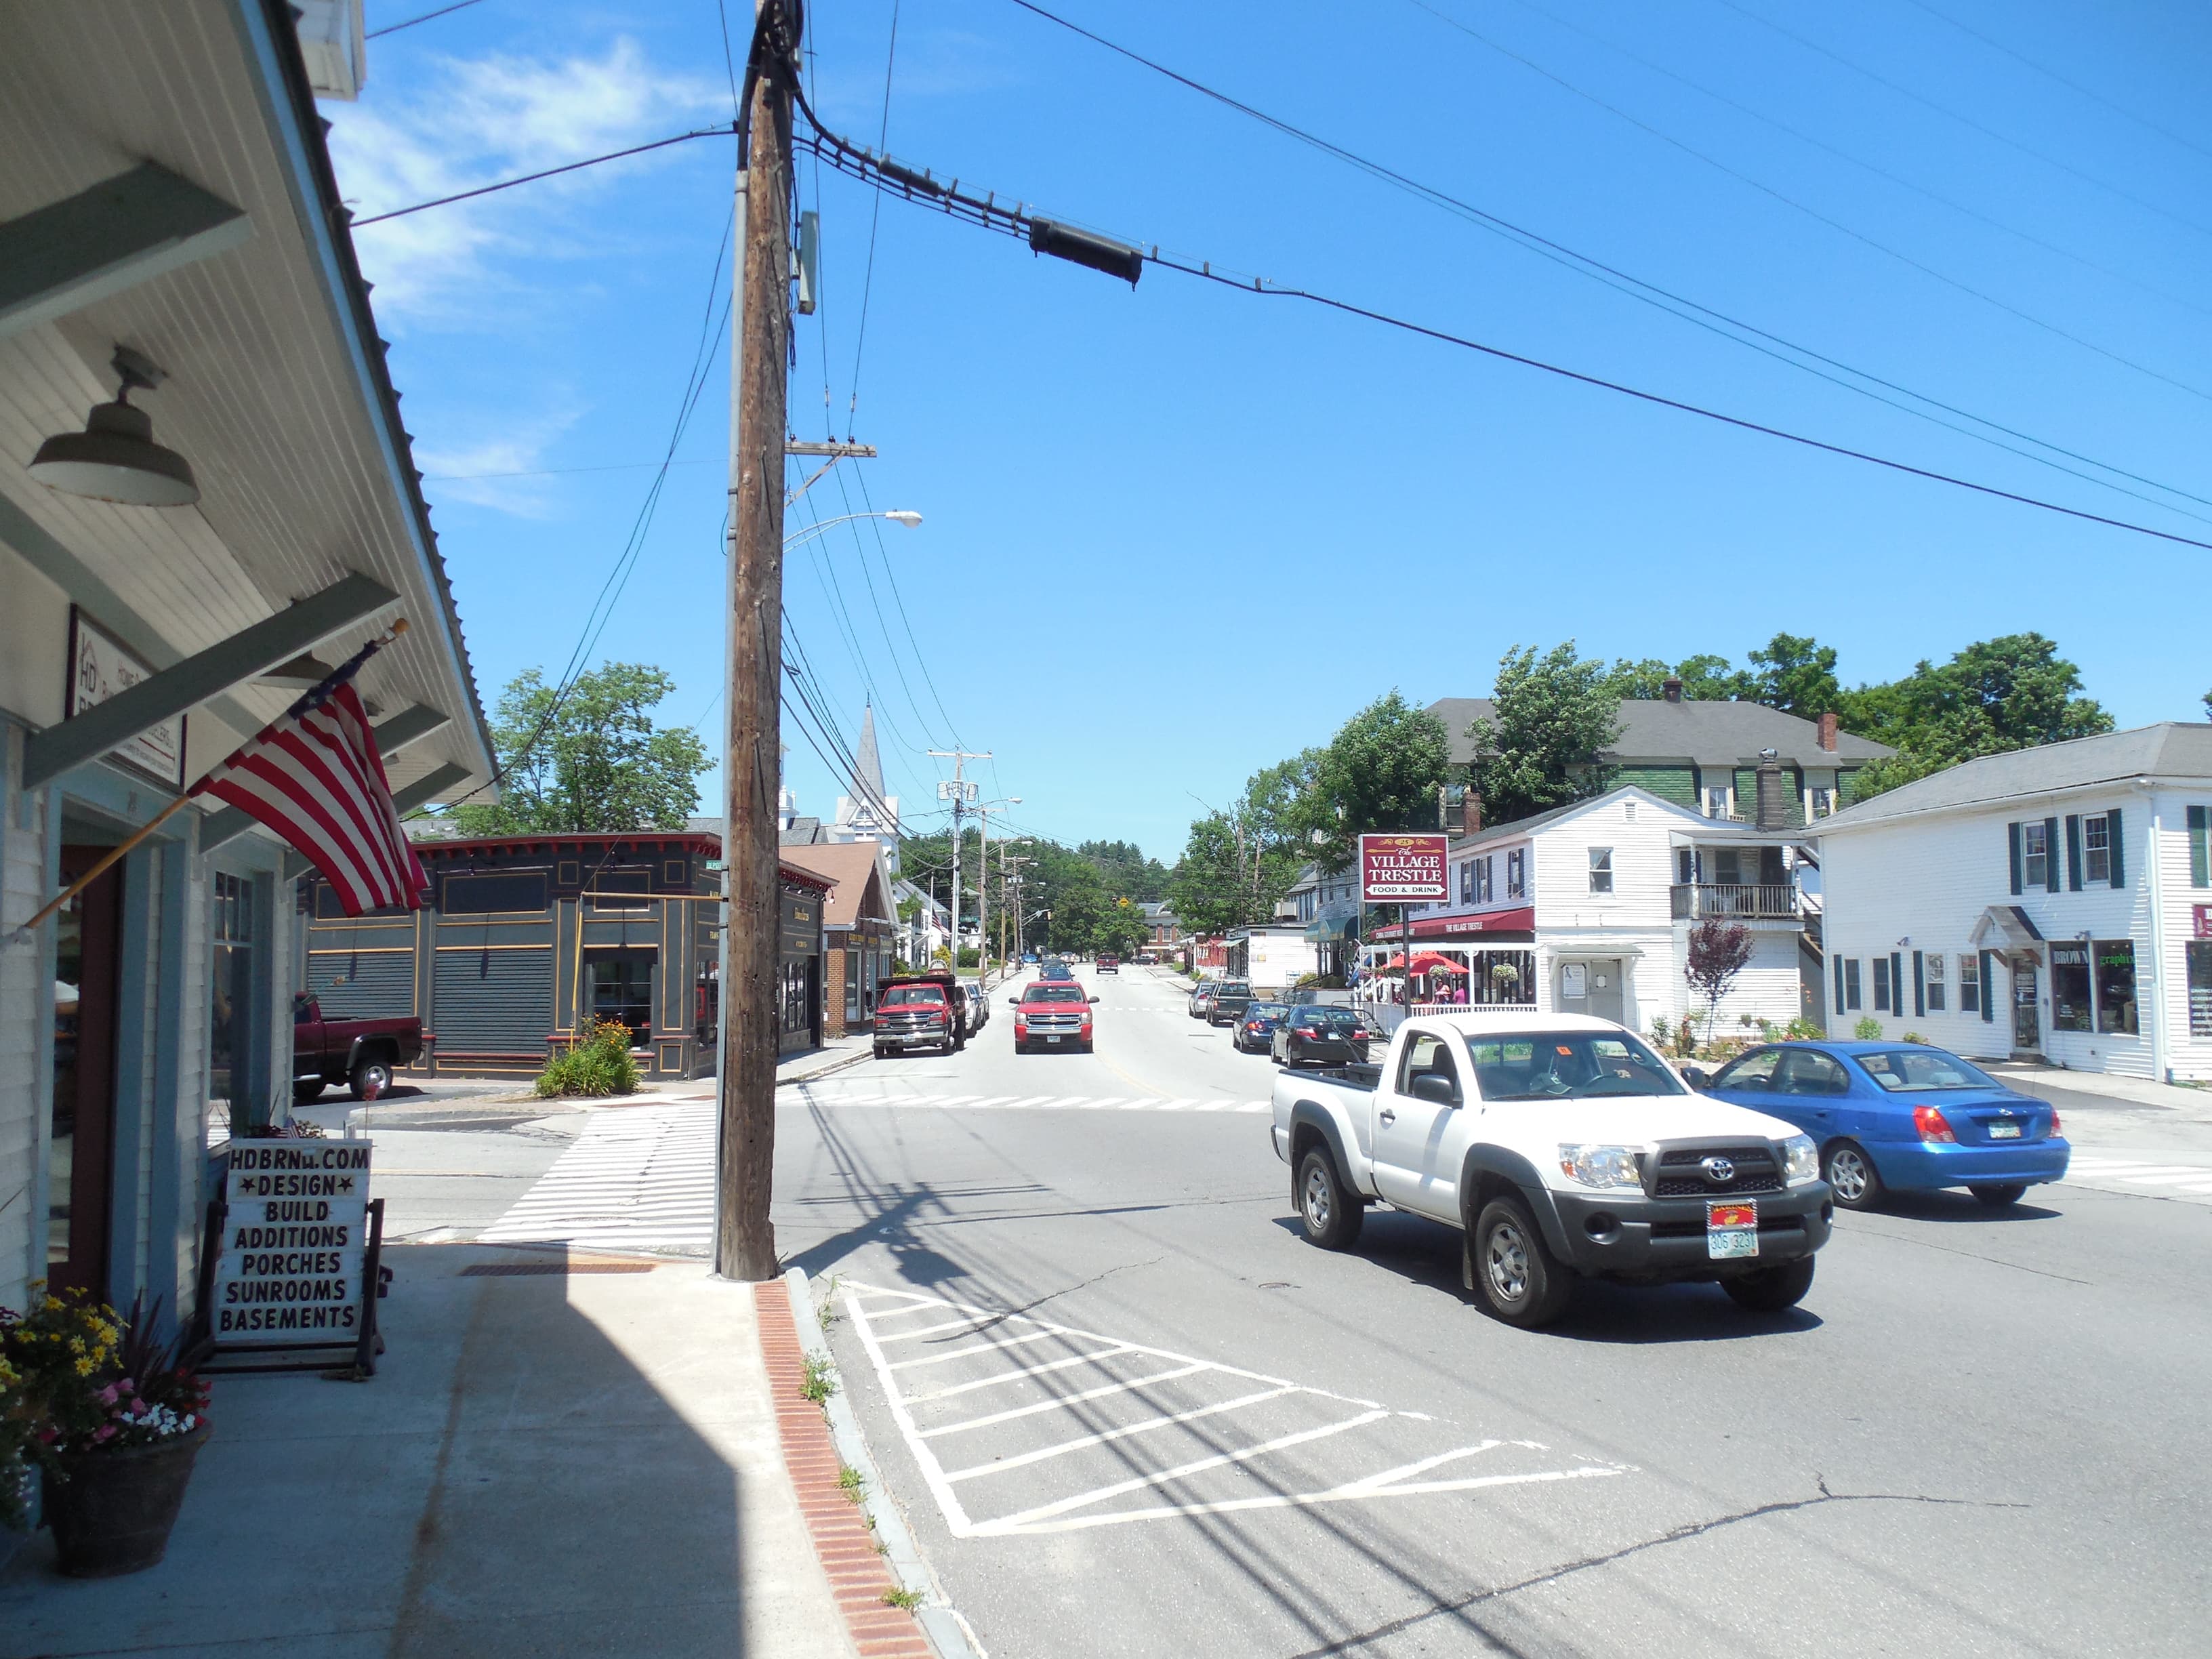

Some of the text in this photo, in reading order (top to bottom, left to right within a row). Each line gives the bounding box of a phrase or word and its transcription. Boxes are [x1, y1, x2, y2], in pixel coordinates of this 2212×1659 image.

[1395, 846, 1413, 856] The
[1370, 856, 1440, 868] VILLAGE
[1368, 869, 1442, 882] TRESTLE
[1453, 923, 1467, 931] VILLAGE
[1467, 922, 1483, 930] TRESTLE
[2053, 950, 2088, 964] BROWN
[258, 1174, 335, 1196] DESIGN
[266, 1201, 329, 1222] BUILD
[234, 1226, 348, 1249] ADDITIONS
[242, 1252, 341, 1275] PORCHES
[226, 1279, 346, 1303] SUNROOMS
[220, 1305, 354, 1332] BASEMENTS
